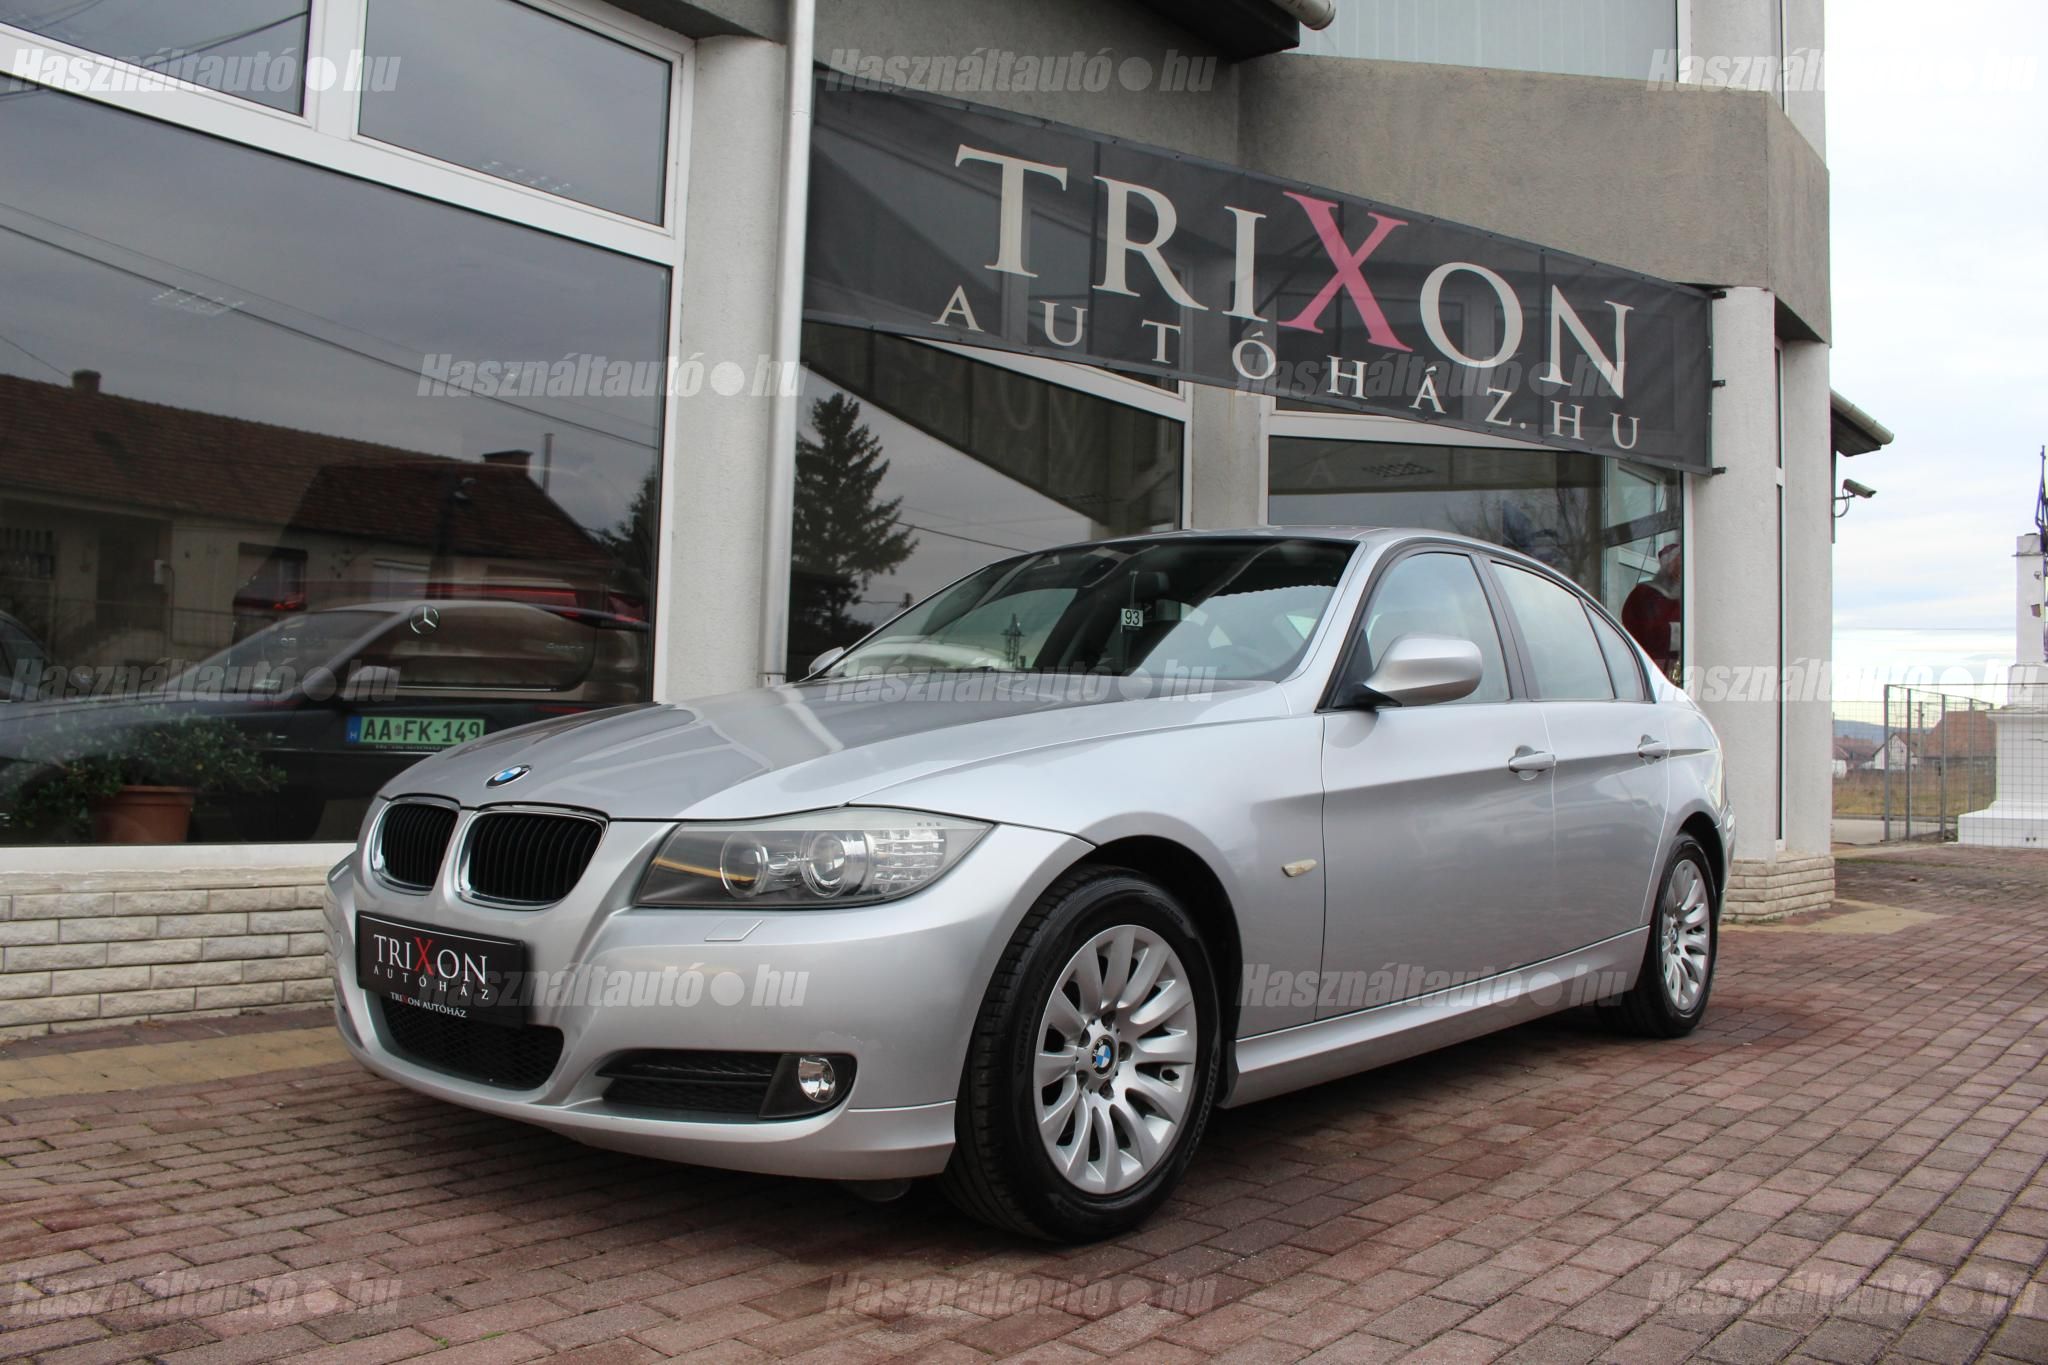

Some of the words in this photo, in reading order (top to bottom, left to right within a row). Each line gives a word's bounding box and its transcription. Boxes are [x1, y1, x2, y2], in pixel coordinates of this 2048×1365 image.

[954, 143, 1635, 400] TRIXON
[1124, 609, 1140, 626] 93
[363, 718, 393, 741] AA
[373, 933, 488, 985] TRIXON
[373, 965, 489, 1001] AUTÓHÁZ
[422, 1001, 467, 1018] AUTÓHÁZ
